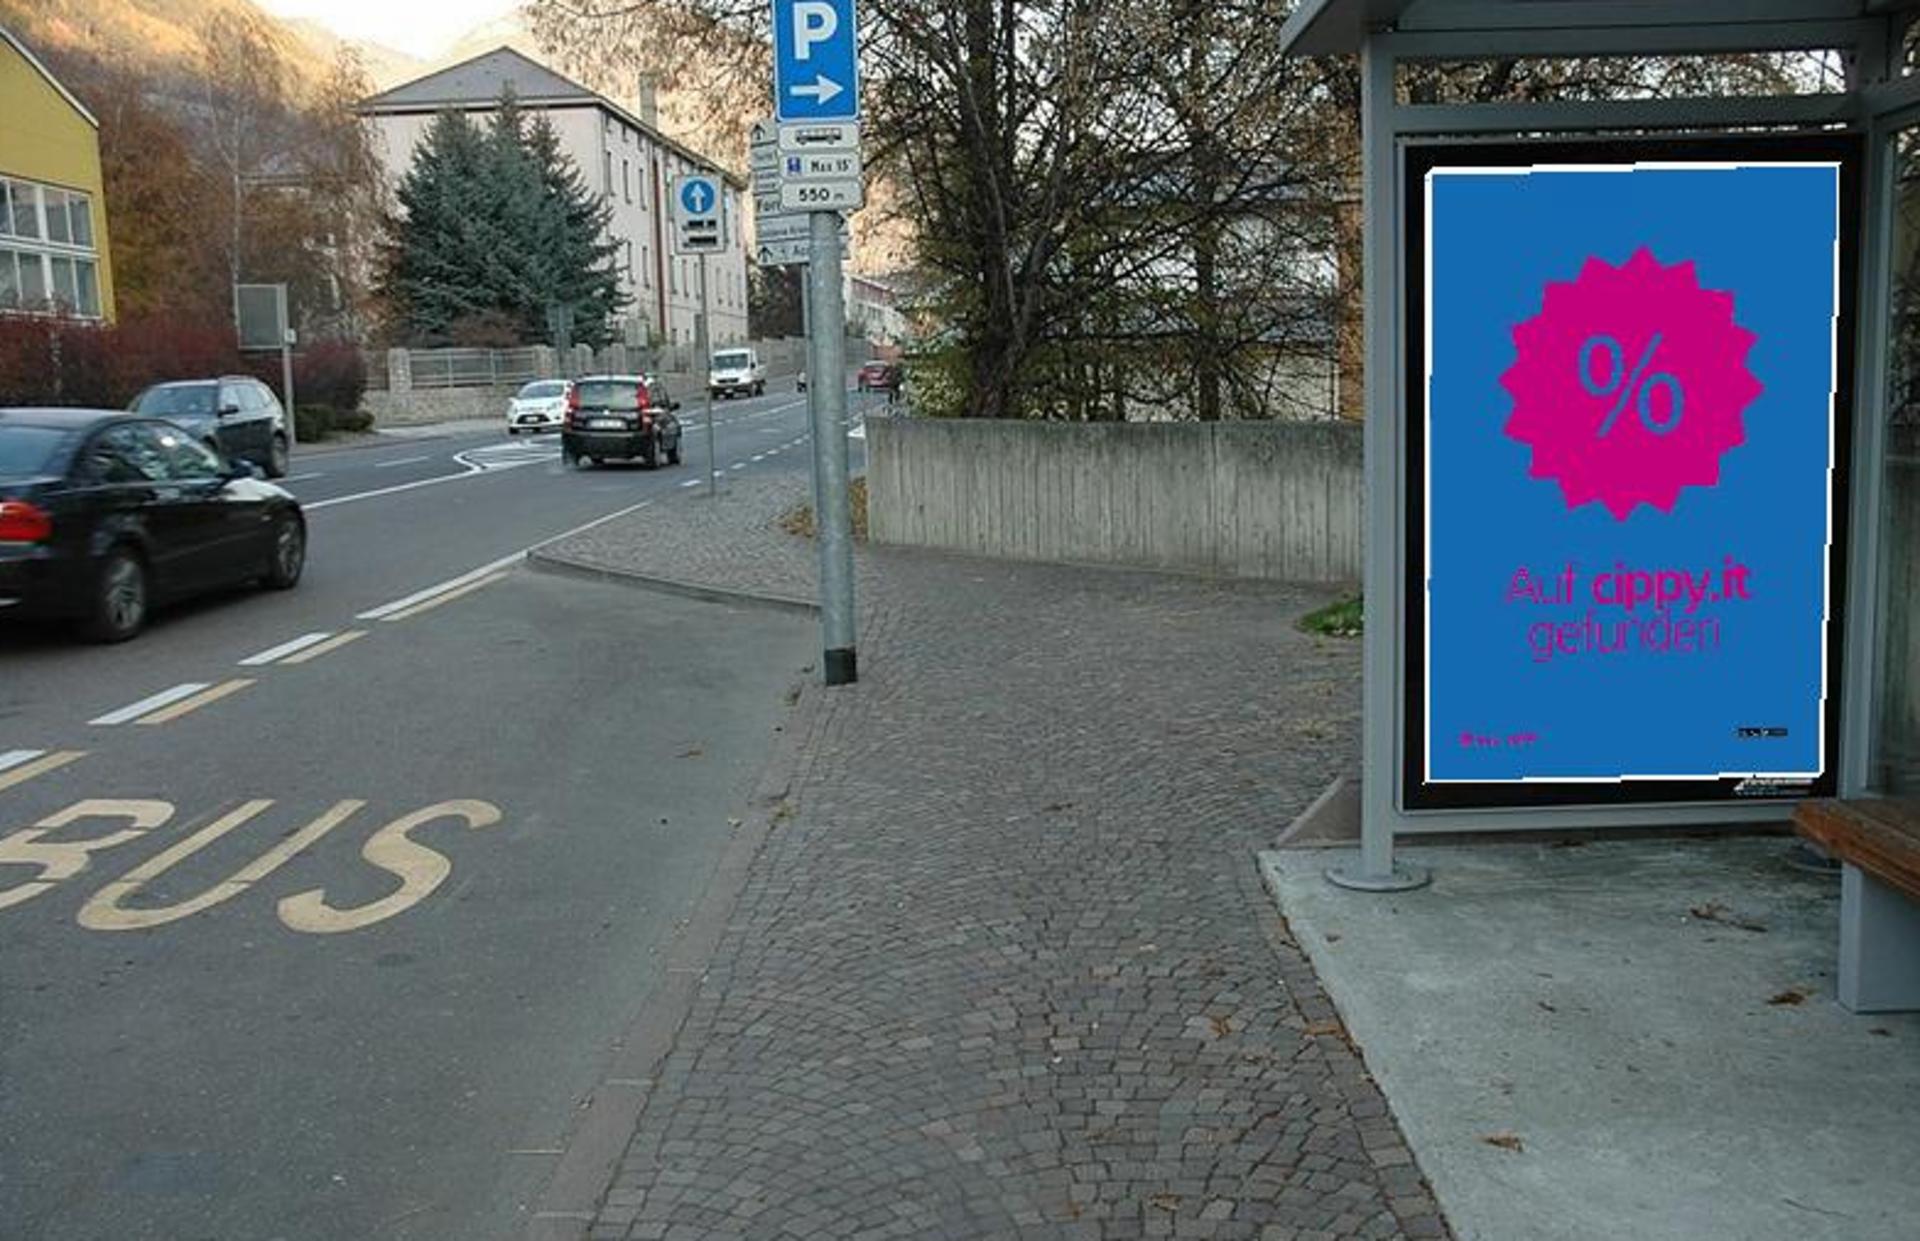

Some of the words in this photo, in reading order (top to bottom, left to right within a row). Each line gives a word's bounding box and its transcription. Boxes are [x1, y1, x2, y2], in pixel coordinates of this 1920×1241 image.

[793, 2, 837, 60] P
[799, 187, 830, 203] 550
[1578, 331, 1684, 439] %
[1507, 562, 1576, 604] Auf
[1591, 554, 1751, 613] cippy.it
[1527, 607, 1721, 663] gefunden
[0, 799, 501, 932] BUS
